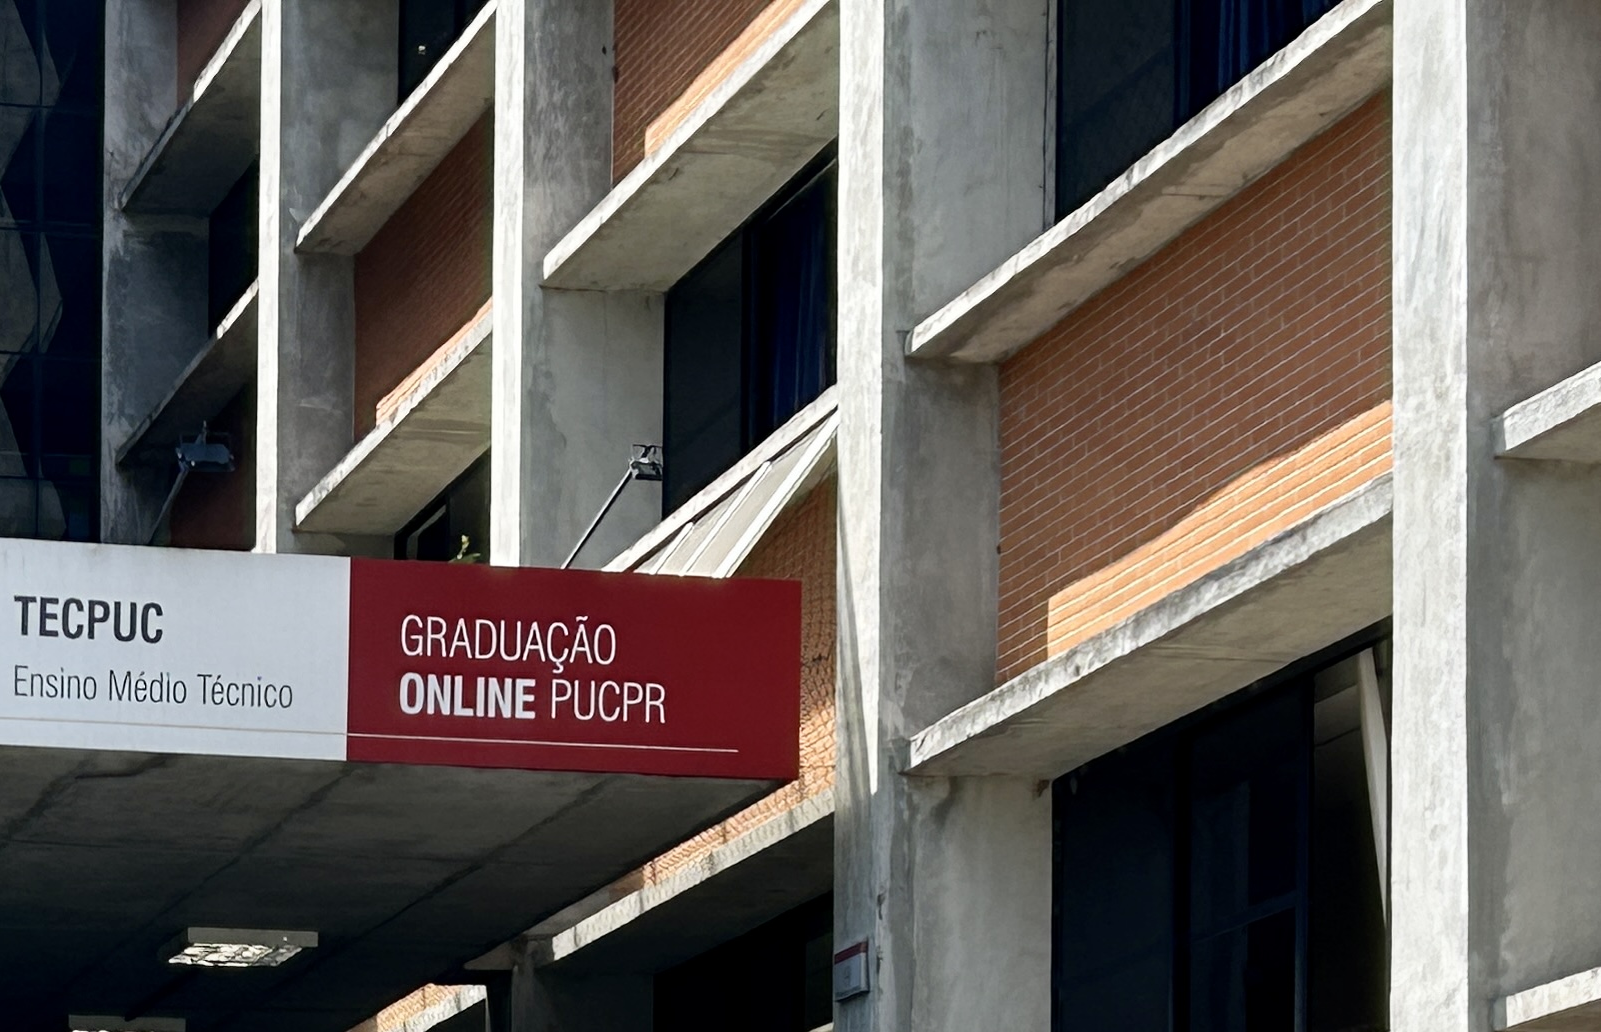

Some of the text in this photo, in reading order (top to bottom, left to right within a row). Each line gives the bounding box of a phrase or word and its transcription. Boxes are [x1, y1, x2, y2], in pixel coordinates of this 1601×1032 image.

[13, 595, 164, 644] TECPUC
[400, 614, 617, 674] GRADUAÇÃO
[13, 664, 294, 709] Ensino Médio Técnico
[399, 671, 666, 724] ONLINE PUCPR
